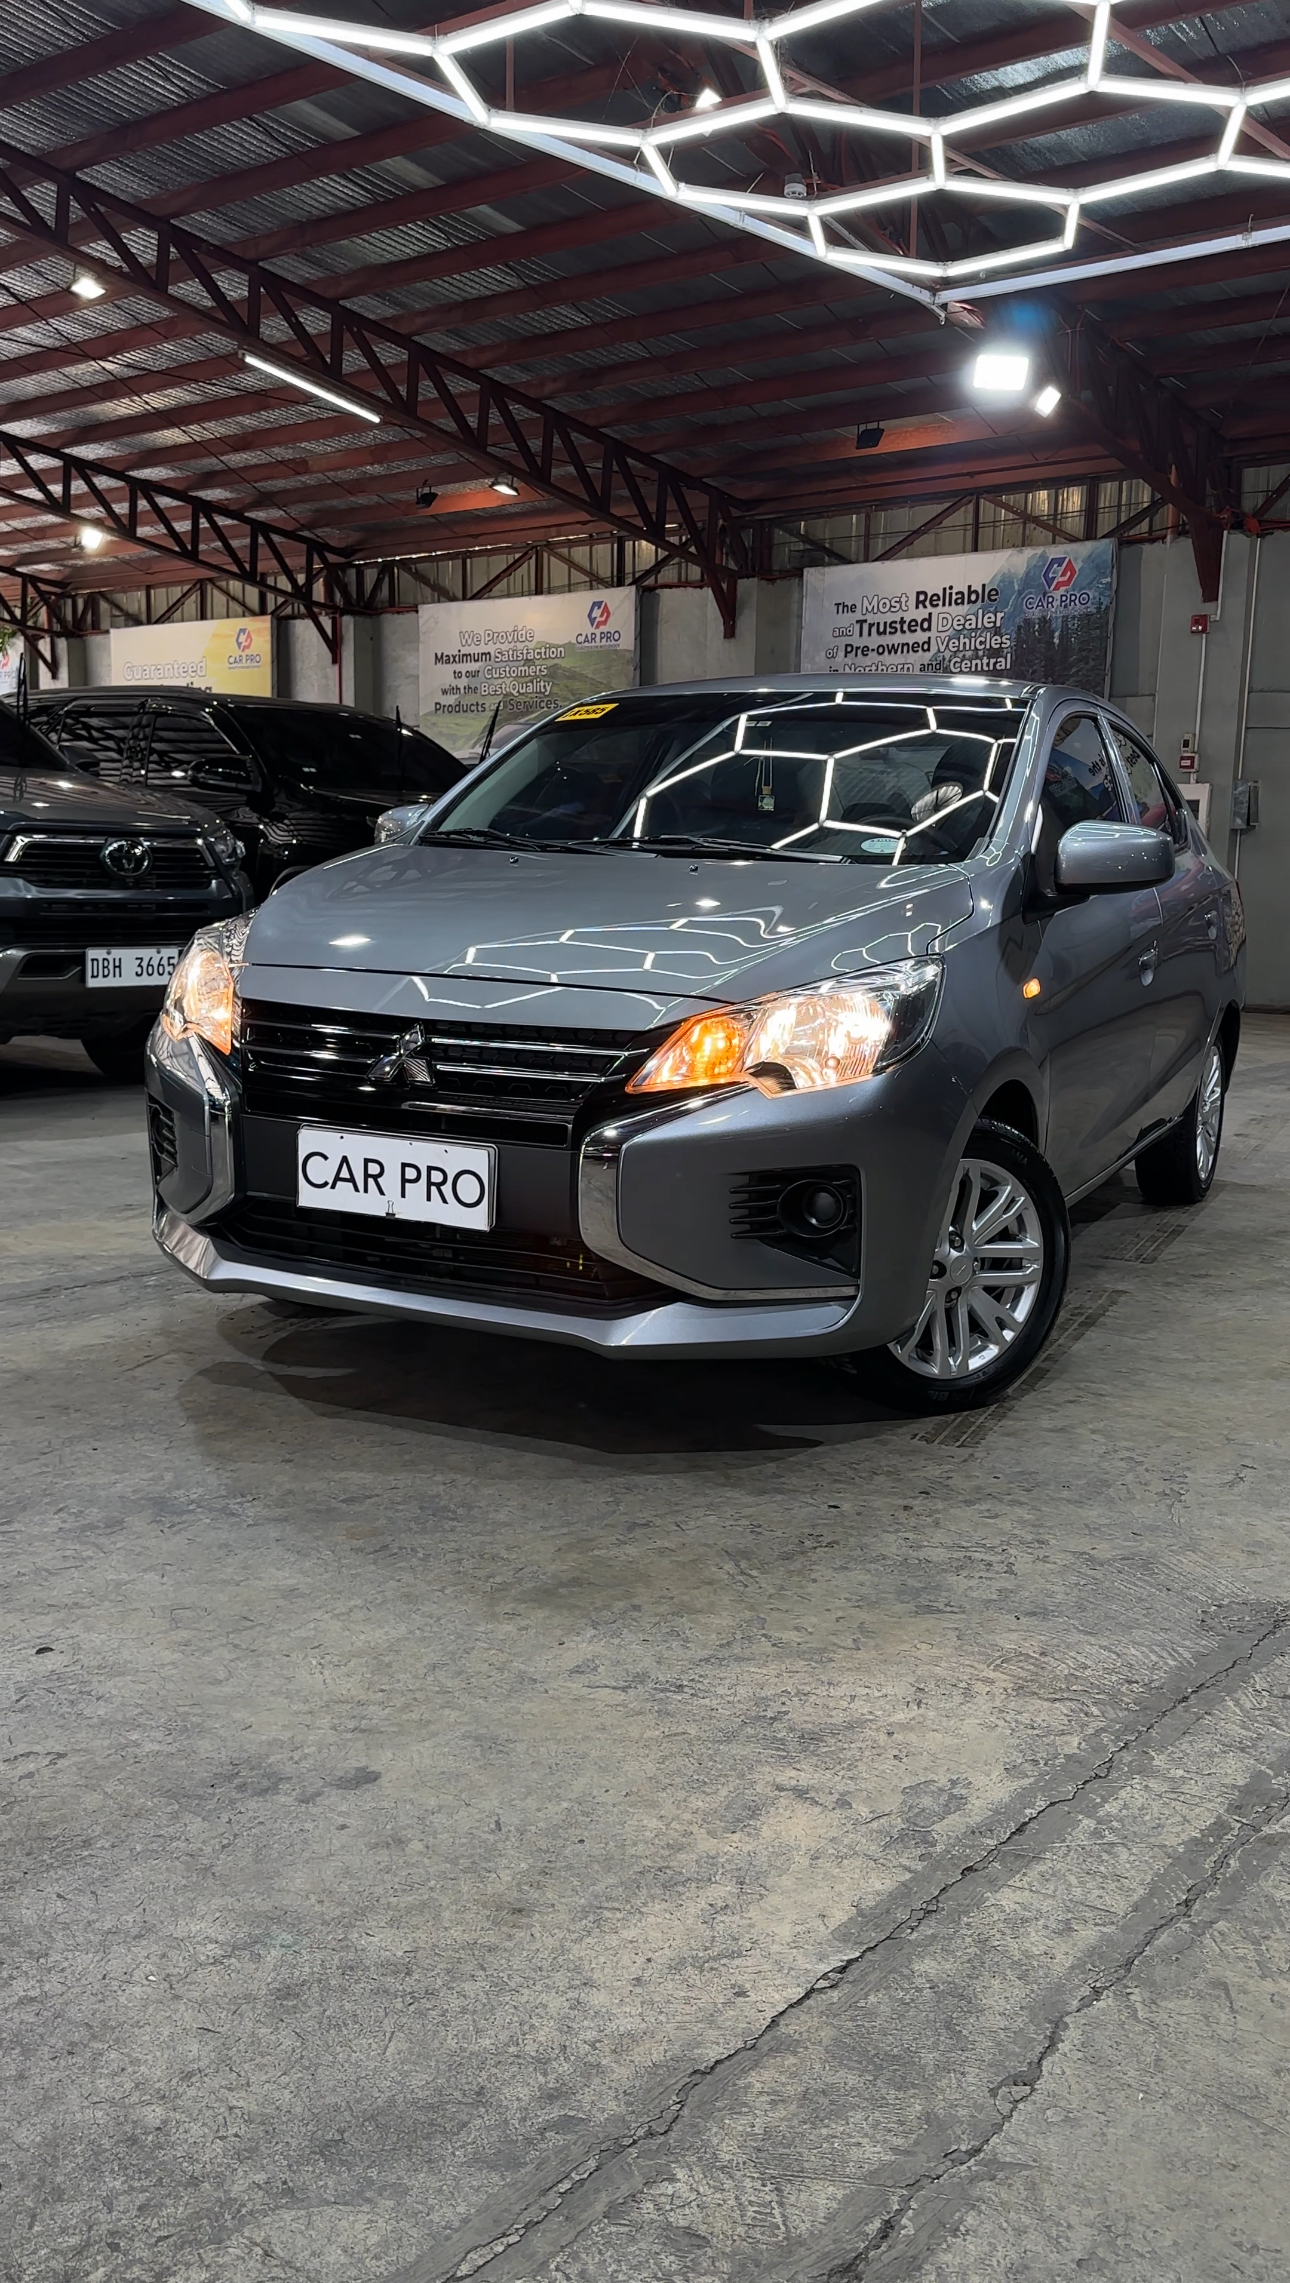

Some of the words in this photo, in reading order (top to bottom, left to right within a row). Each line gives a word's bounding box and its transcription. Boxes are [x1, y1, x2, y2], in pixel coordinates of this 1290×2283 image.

[834, 602, 857, 615] The
[861, 593, 909, 615] Most
[915, 584, 999, 610] Reliable
[1025, 595, 1055, 610] CAR
[1060, 592, 1090, 607] PRO
[832, 623, 854, 638] and
[856, 612, 932, 638] Trusted
[936, 608, 1005, 633] Dealer
[459, 630, 482, 647] We
[483, 625, 535, 646] Provide
[575, 632, 597, 645] CAR
[600, 630, 621, 643] PRO
[826, 645, 838, 659] of
[844, 636, 931, 658] Pre-owned
[936, 631, 1011, 653] Vehicles
[227, 654, 243, 665] CAR
[245, 653, 262, 664] PRO
[434, 650, 492, 666] Maximum
[493, 643, 565, 663] Satisfaction
[919, 659, 942, 673] and
[950, 653, 1012, 674] Central
[123, 656, 207, 681] Guaranteed
[453, 669, 463, 680] to
[465, 669, 480, 679] our
[484, 664, 548, 680] Customers
[441, 685, 461, 696] with
[463, 684, 479, 695] the
[480, 681, 507, 697] Best
[509, 678, 553, 697] Quality
[434, 700, 487, 714] Products
[90, 957, 123, 979] DBH
[135, 956, 176, 978] 3665
[301, 1151, 386, 1197] CAR
[400, 1161, 486, 1209] PRO
